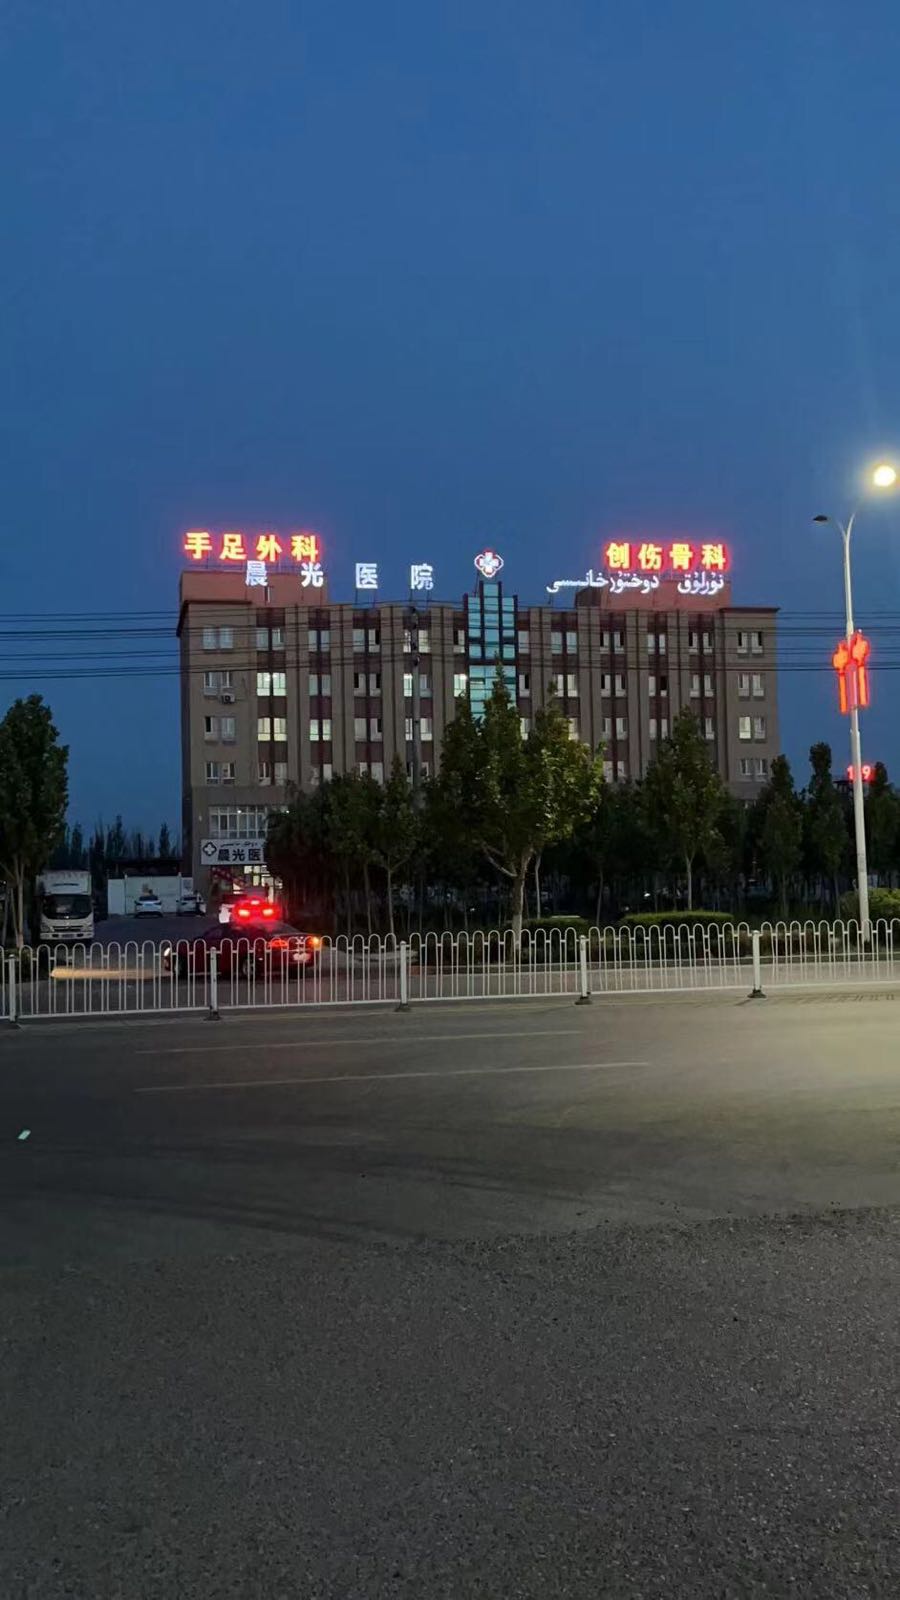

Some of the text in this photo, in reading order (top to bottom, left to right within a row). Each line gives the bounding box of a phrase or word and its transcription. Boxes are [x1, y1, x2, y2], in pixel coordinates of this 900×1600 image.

[184, 532, 319, 561] 手足外科
[606, 542, 726, 570] 创伤骨科
[245, 560, 434, 590] 晨光医院
[847, 765, 871, 780] 19
